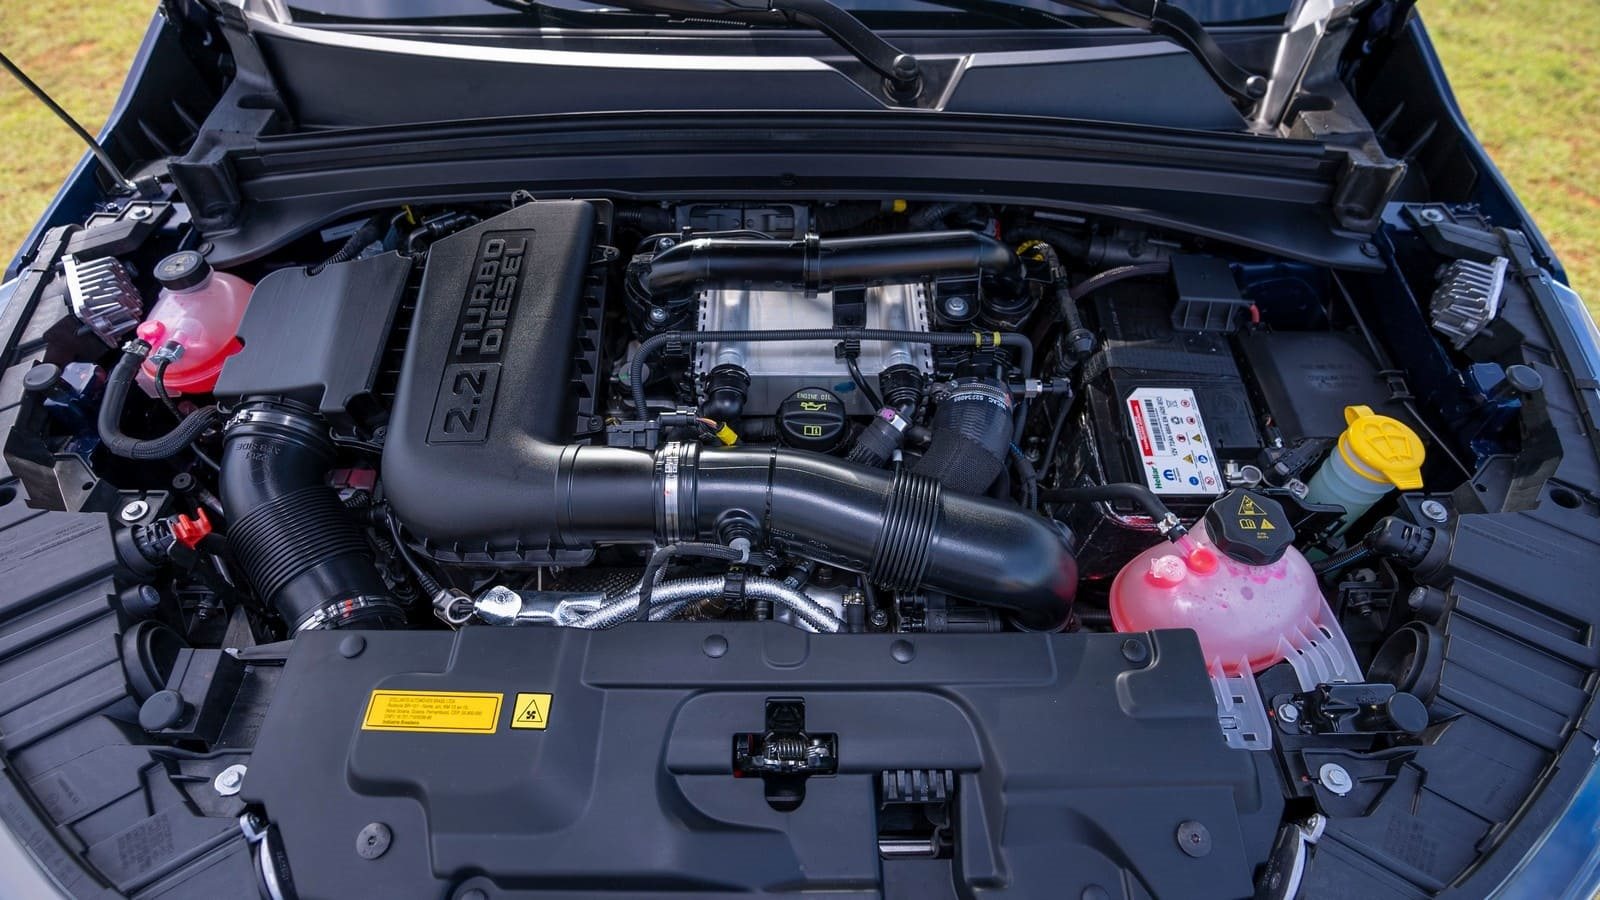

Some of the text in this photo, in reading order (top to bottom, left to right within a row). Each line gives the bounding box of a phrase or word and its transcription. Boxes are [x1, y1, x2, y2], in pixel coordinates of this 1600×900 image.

[455, 238, 506, 356] TURBO
[480, 237, 529, 355] DIESEL
[443, 369, 488, 434] 2.2
[796, 392, 818, 400] ENGINE
[1152, 466, 1163, 489] Heliar
